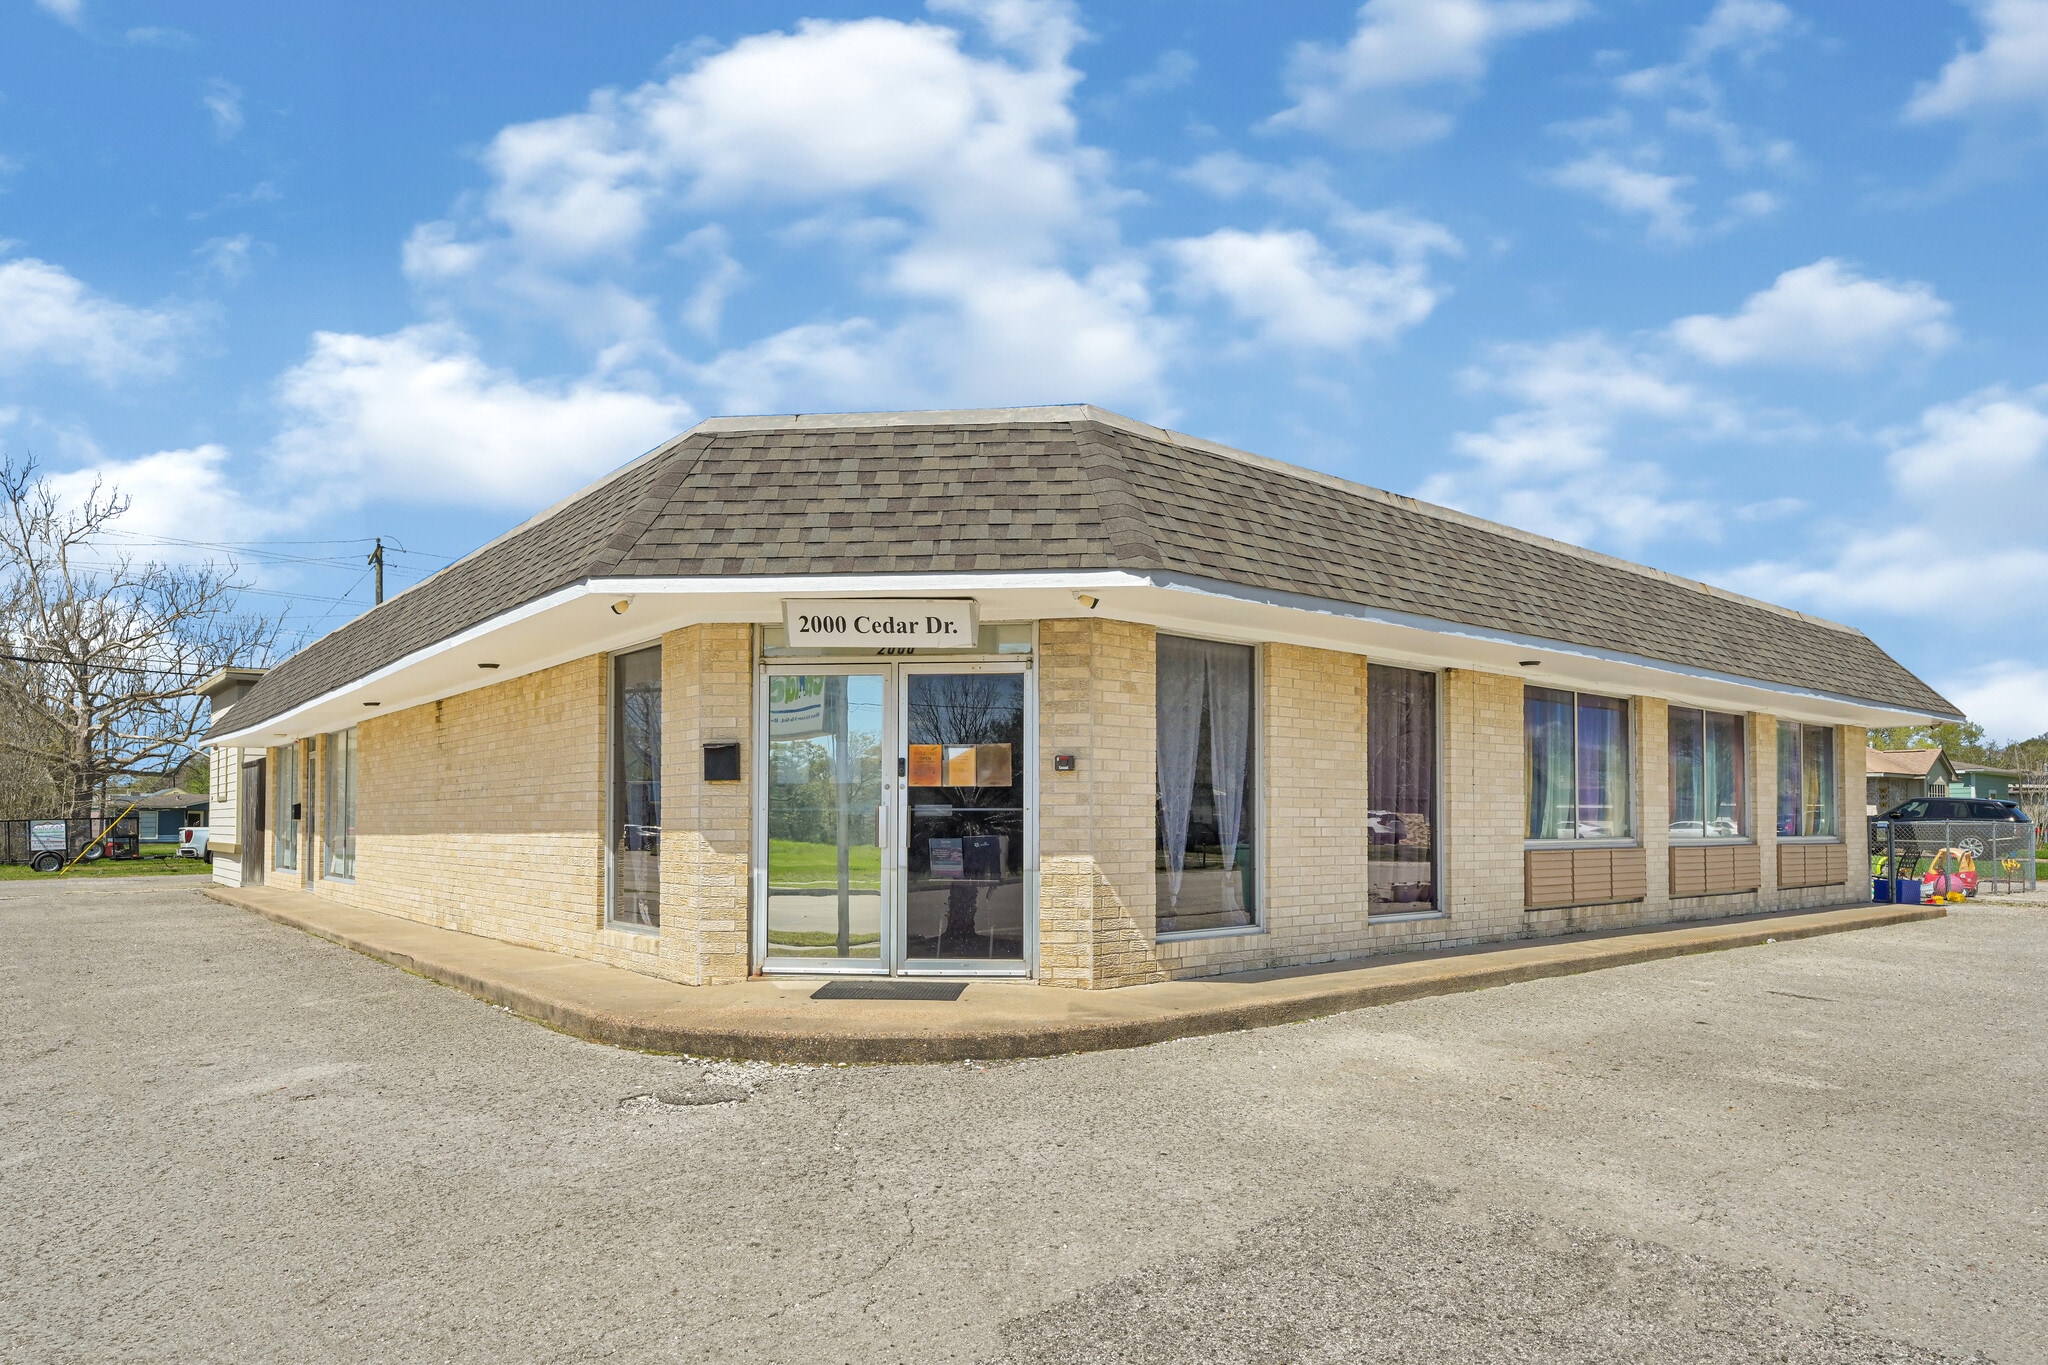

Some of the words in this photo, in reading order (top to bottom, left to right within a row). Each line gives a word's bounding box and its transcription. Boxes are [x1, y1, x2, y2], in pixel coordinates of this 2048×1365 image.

[799, 616, 847, 633] 2000
[854, 616, 919, 634] Cedar
[925, 616, 958, 634] Dr.
